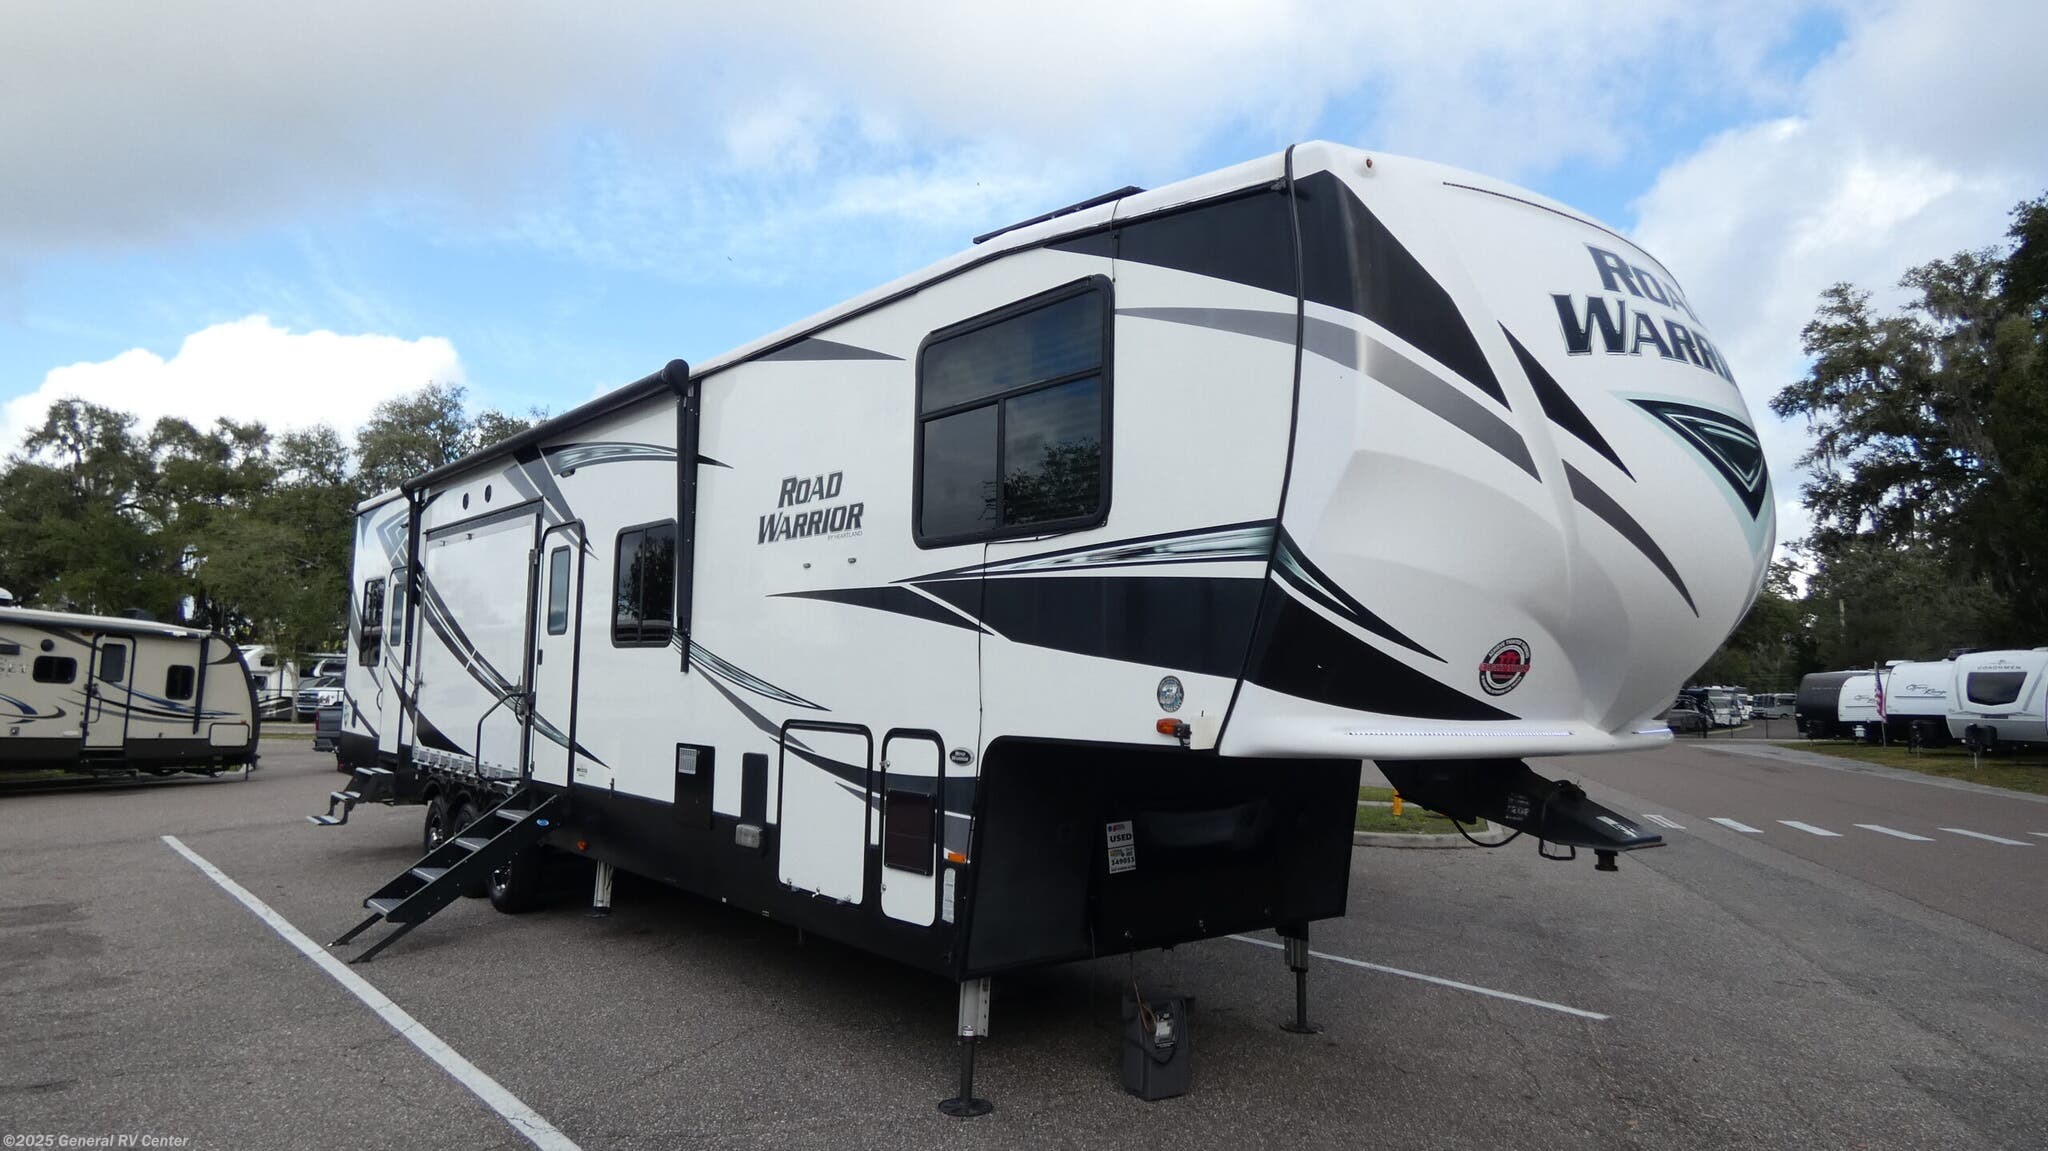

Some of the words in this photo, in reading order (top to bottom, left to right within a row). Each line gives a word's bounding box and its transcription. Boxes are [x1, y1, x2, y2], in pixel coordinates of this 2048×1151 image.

[1583, 242, 1701, 323] ROA
[1550, 290, 1734, 385] WARRI
[777, 471, 843, 509] ROAD
[757, 502, 865, 545] WARRIOR
[1110, 833, 1132, 843] USED
